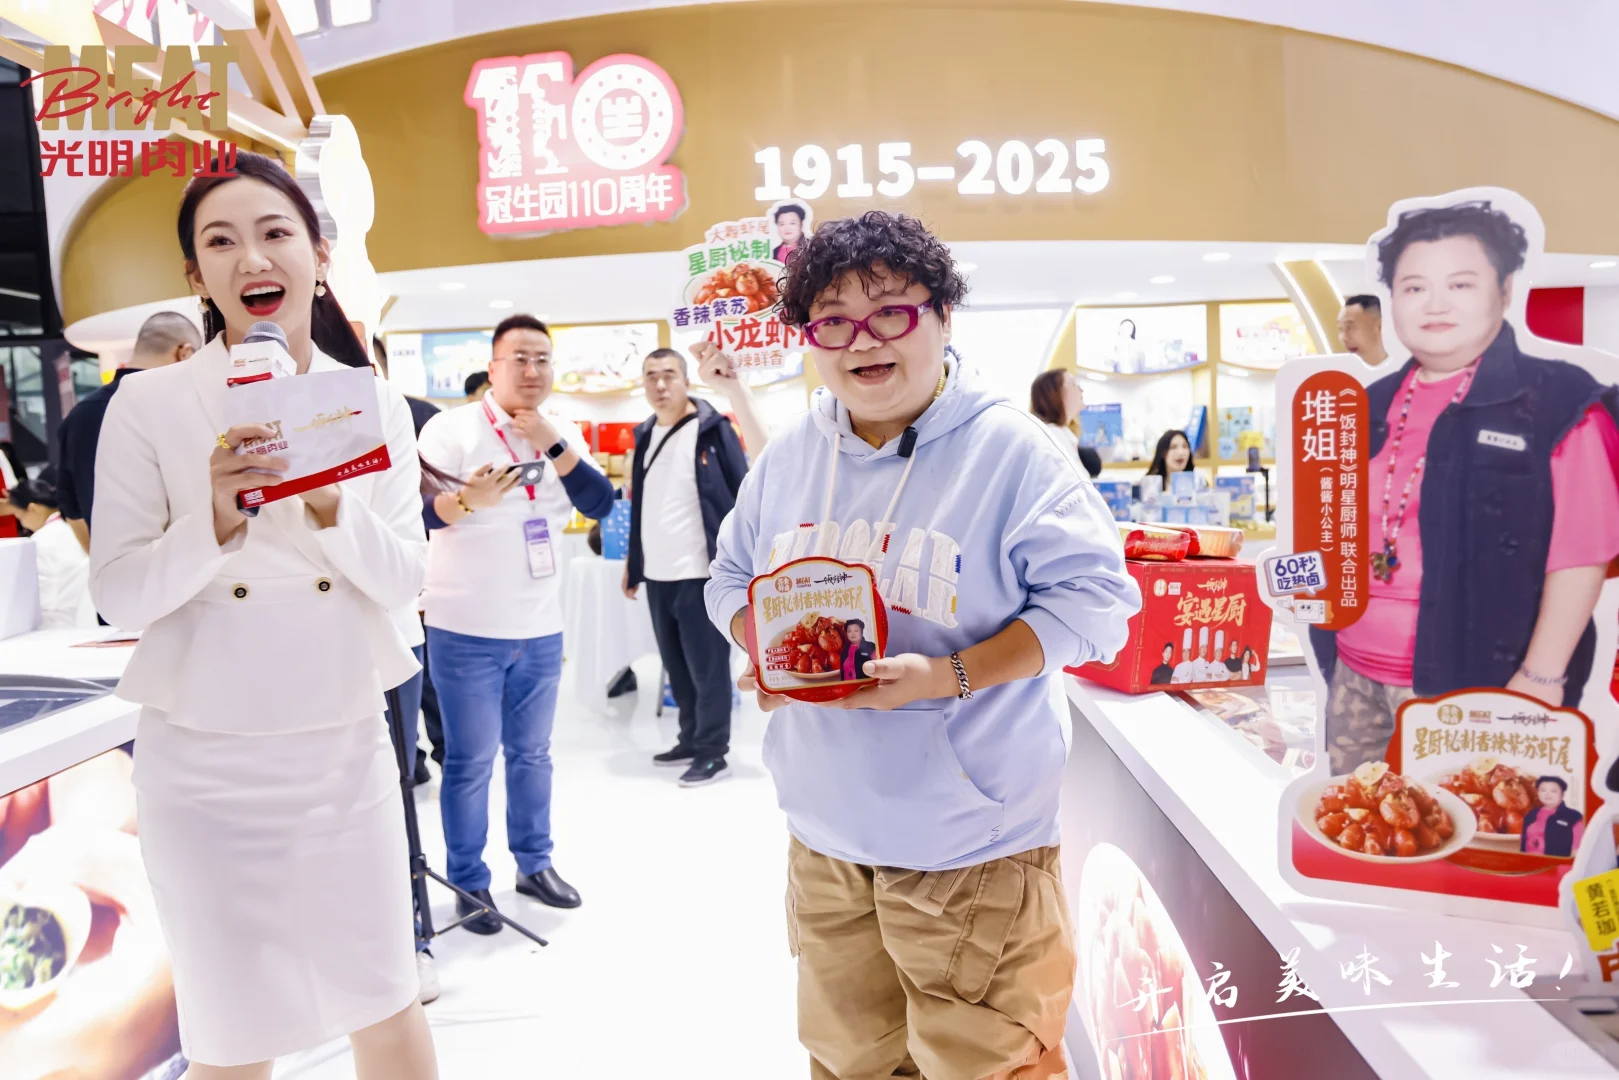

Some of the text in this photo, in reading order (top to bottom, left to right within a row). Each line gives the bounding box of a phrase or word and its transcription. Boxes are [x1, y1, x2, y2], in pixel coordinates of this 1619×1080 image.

[485, 172, 674, 225] 冠生园110周年
[688, 238, 771, 277] 星厨秘制
[673, 298, 746, 327] 香辣紫苏
[1301, 390, 1338, 463] 堆姐
[1274, 555, 1317, 577] 60秒
[1277, 572, 1320, 591] 吃热卤
[1173, 591, 1247, 629] 宴遇星厨
[1413, 726, 1573, 774] 星厨秘制香辣紫苏虾尾
